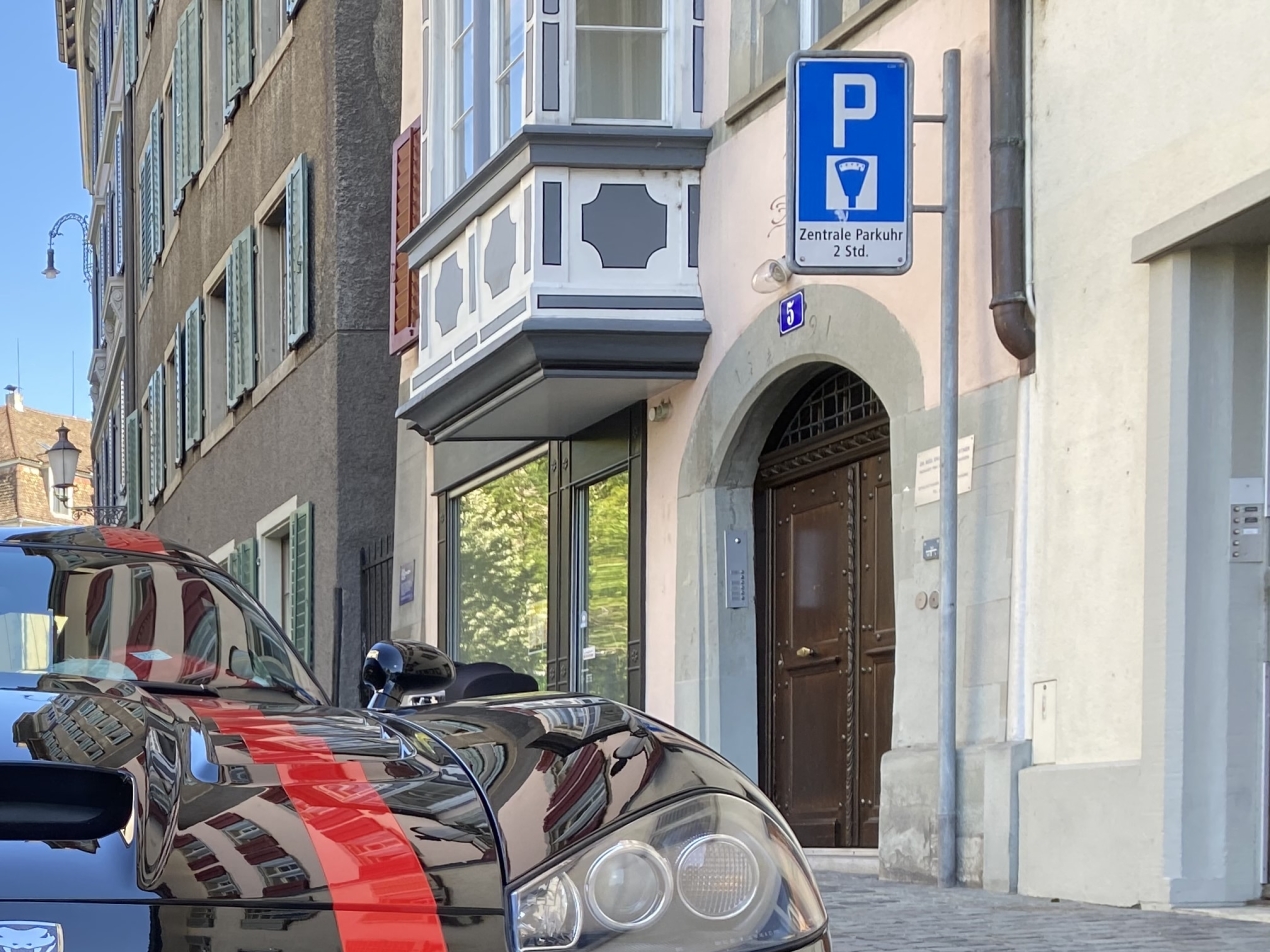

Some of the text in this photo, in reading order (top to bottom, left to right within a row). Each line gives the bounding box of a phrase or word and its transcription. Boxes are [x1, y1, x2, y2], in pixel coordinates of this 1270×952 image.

[833, 73, 877, 148] P
[799, 227, 904, 241] Zentrale Parkuhr
[833, 243, 869, 258] 2 Std.
[786, 299, 796, 326] 5
